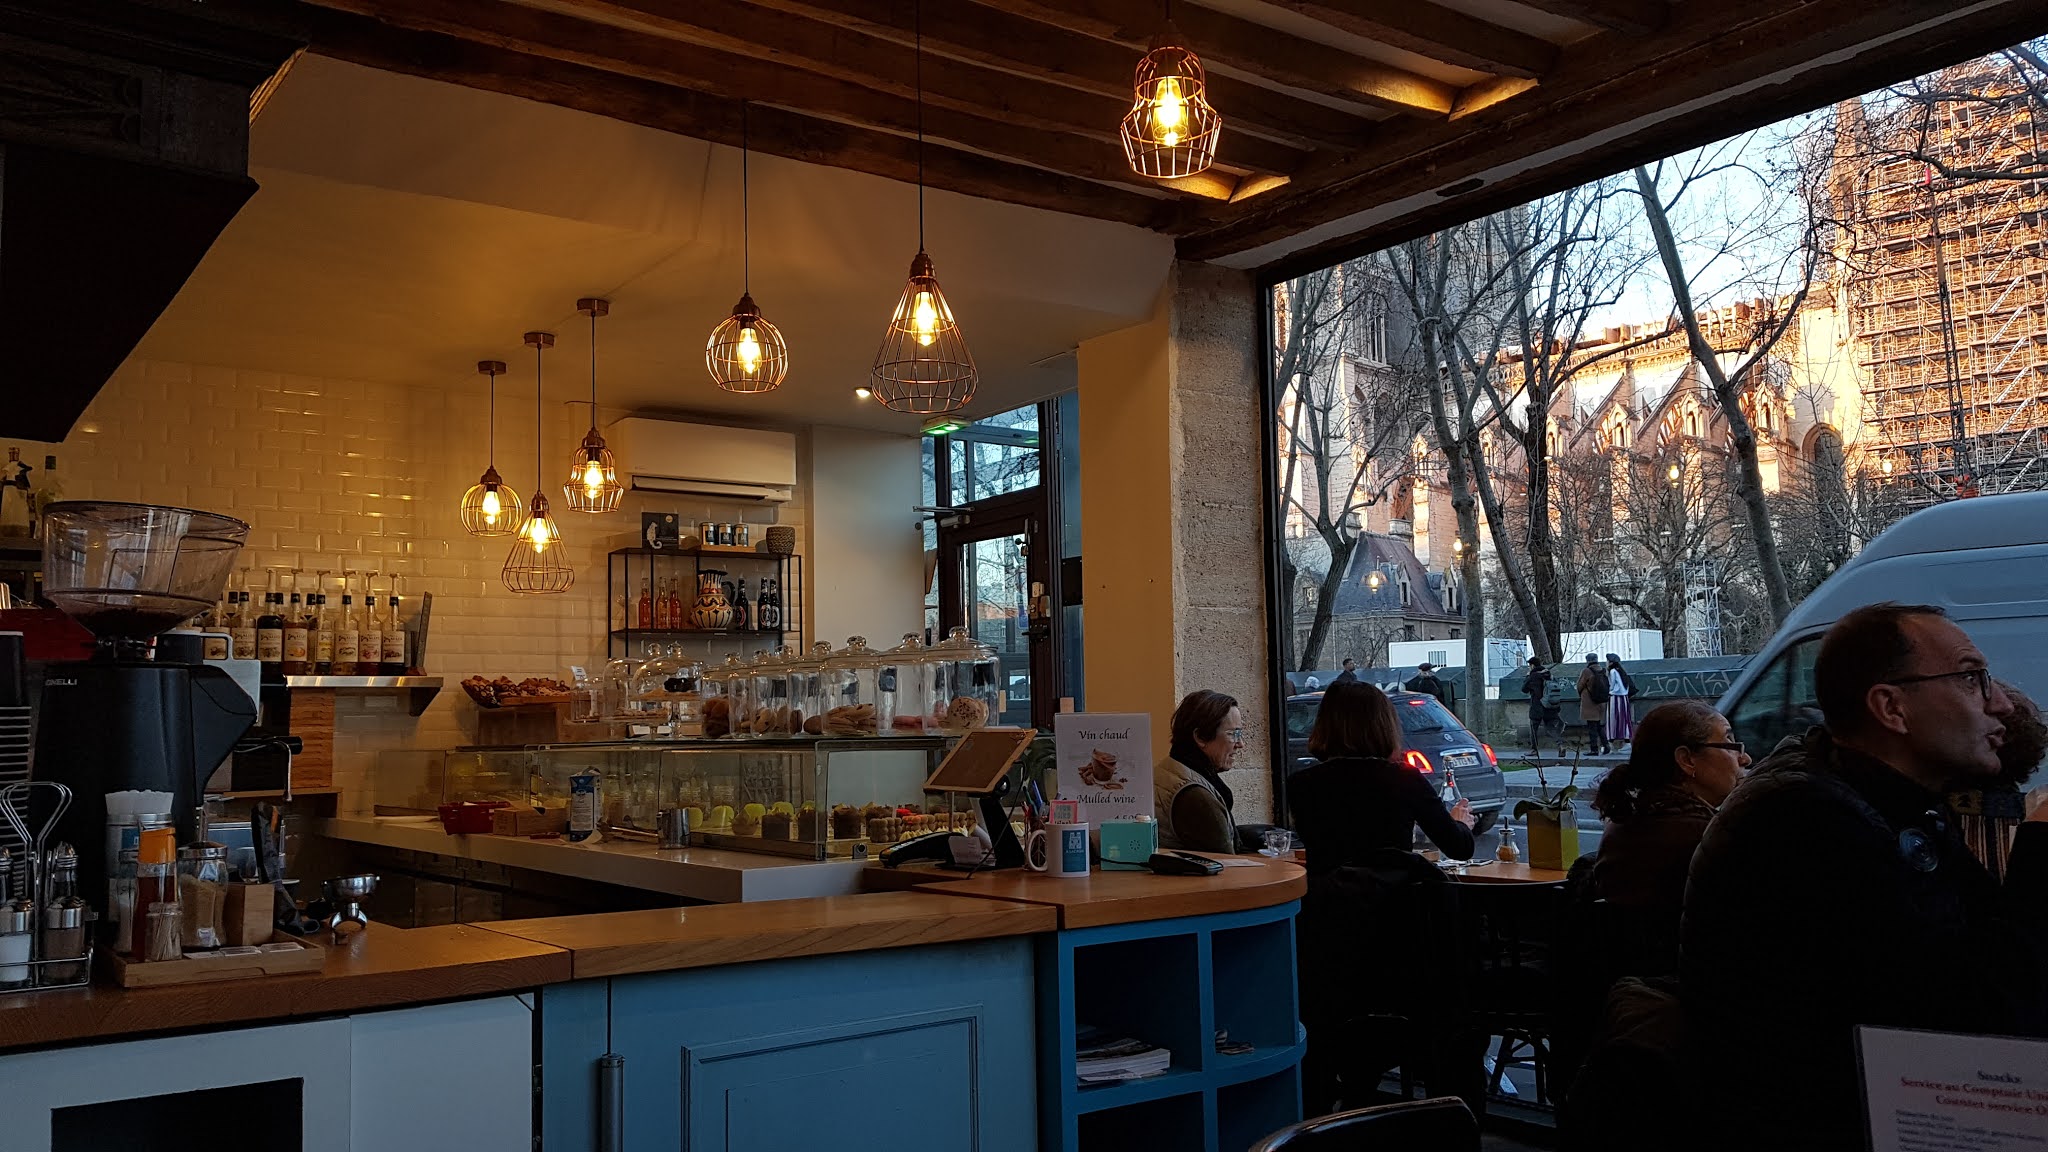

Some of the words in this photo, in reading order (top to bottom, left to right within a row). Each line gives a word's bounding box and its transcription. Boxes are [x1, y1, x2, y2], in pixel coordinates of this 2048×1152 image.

[1078, 730, 1096, 740] Vin
[1099, 727, 1131, 740] chaud
[1077, 791, 1113, 804] Mulled
[1113, 794, 1136, 804] wine
[1901, 1076, 1942, 1091] Service
[1988, 1103, 2034, 1114] service
